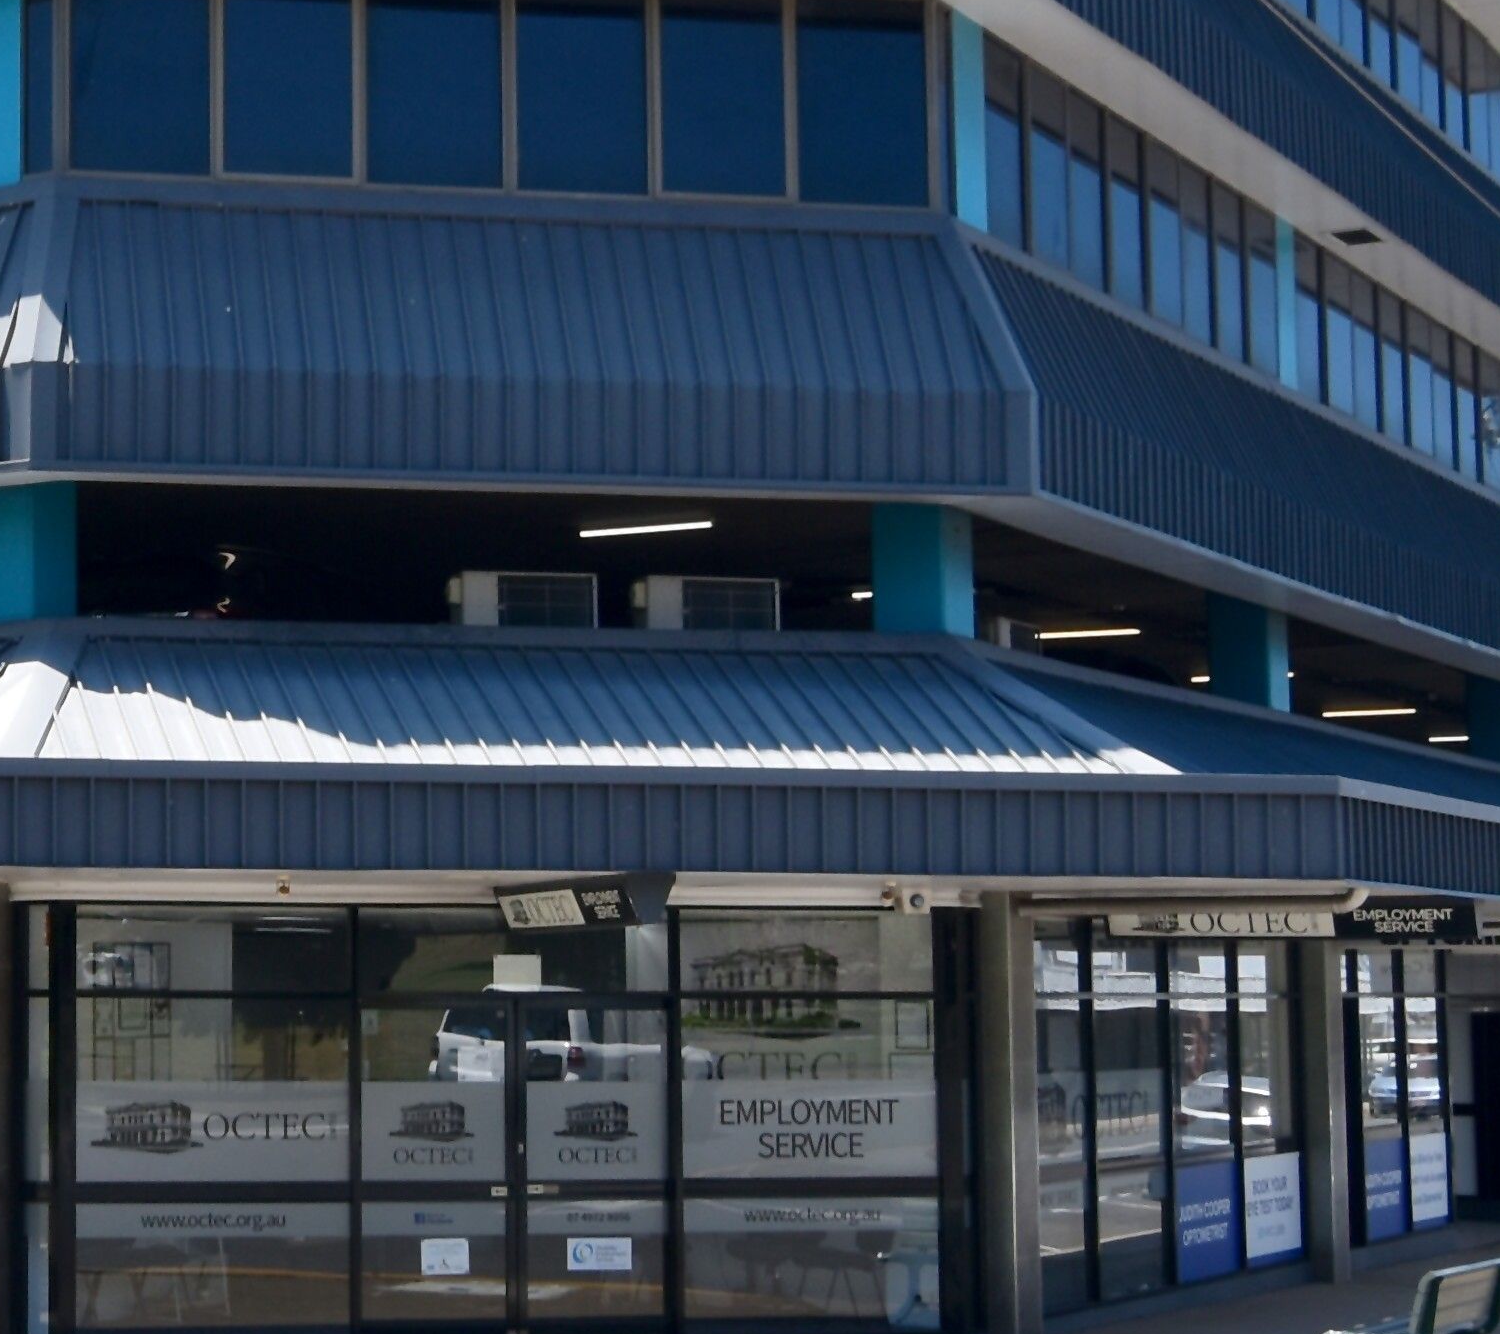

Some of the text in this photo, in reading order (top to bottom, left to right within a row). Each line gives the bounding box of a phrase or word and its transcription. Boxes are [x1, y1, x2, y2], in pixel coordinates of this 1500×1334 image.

[526, 896, 574, 924] OCTEC
[1352, 908, 1453, 921] EMPLOYMENT
[1190, 912, 1307, 934] OCTEC
[1374, 920, 1435, 933] SERVICE
[719, 1099, 899, 1125] EMPLOYMENT
[203, 1111, 326, 1141] OCTEC
[758, 1132, 864, 1158] SERVICE
[393, 1147, 465, 1165] OCTEC
[558, 1147, 629, 1164] OCTEC
[140, 1213, 286, 1232] www.octec.org.au
[743, 1207, 881, 1225] www.octec.org.au
